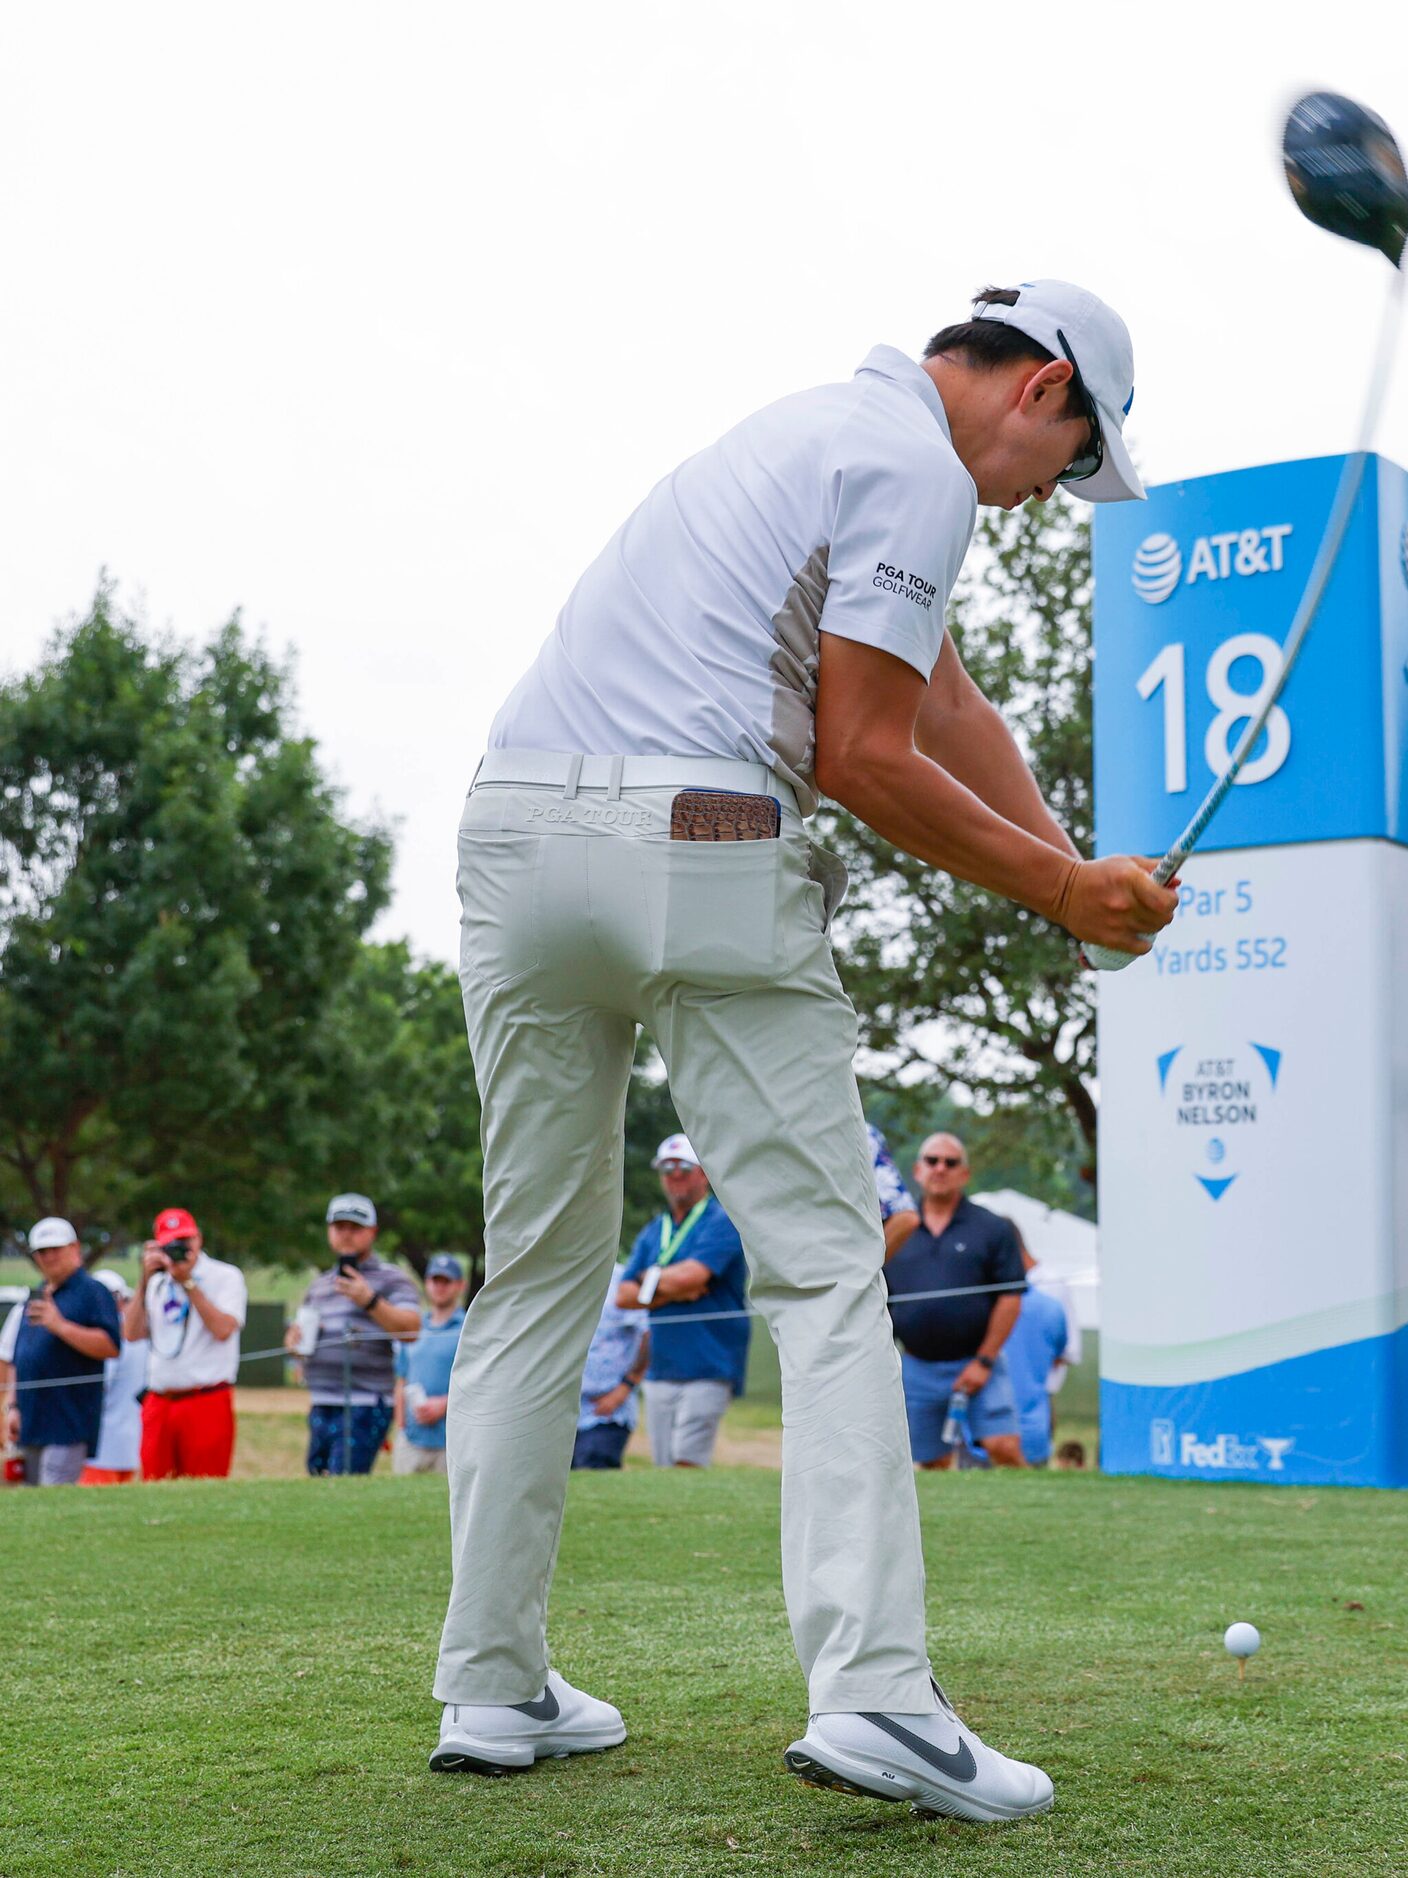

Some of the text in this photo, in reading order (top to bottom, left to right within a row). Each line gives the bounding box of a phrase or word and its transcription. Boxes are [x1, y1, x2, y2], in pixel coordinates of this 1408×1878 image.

[1187, 524, 1293, 584] AT&T
[872, 576, 932, 611] GOLFWEAR
[876, 562, 937, 599] PGA TOUR
[1135, 633, 1291, 794] 18
[526, 806, 652, 827] PGA TOUR
[1178, 881, 1253, 918] Par 5
[1153, 937, 1287, 975] Yards 552
[1183, 1081, 1250, 1102] BYRON
[1178, 1104, 1257, 1126] NELSON
